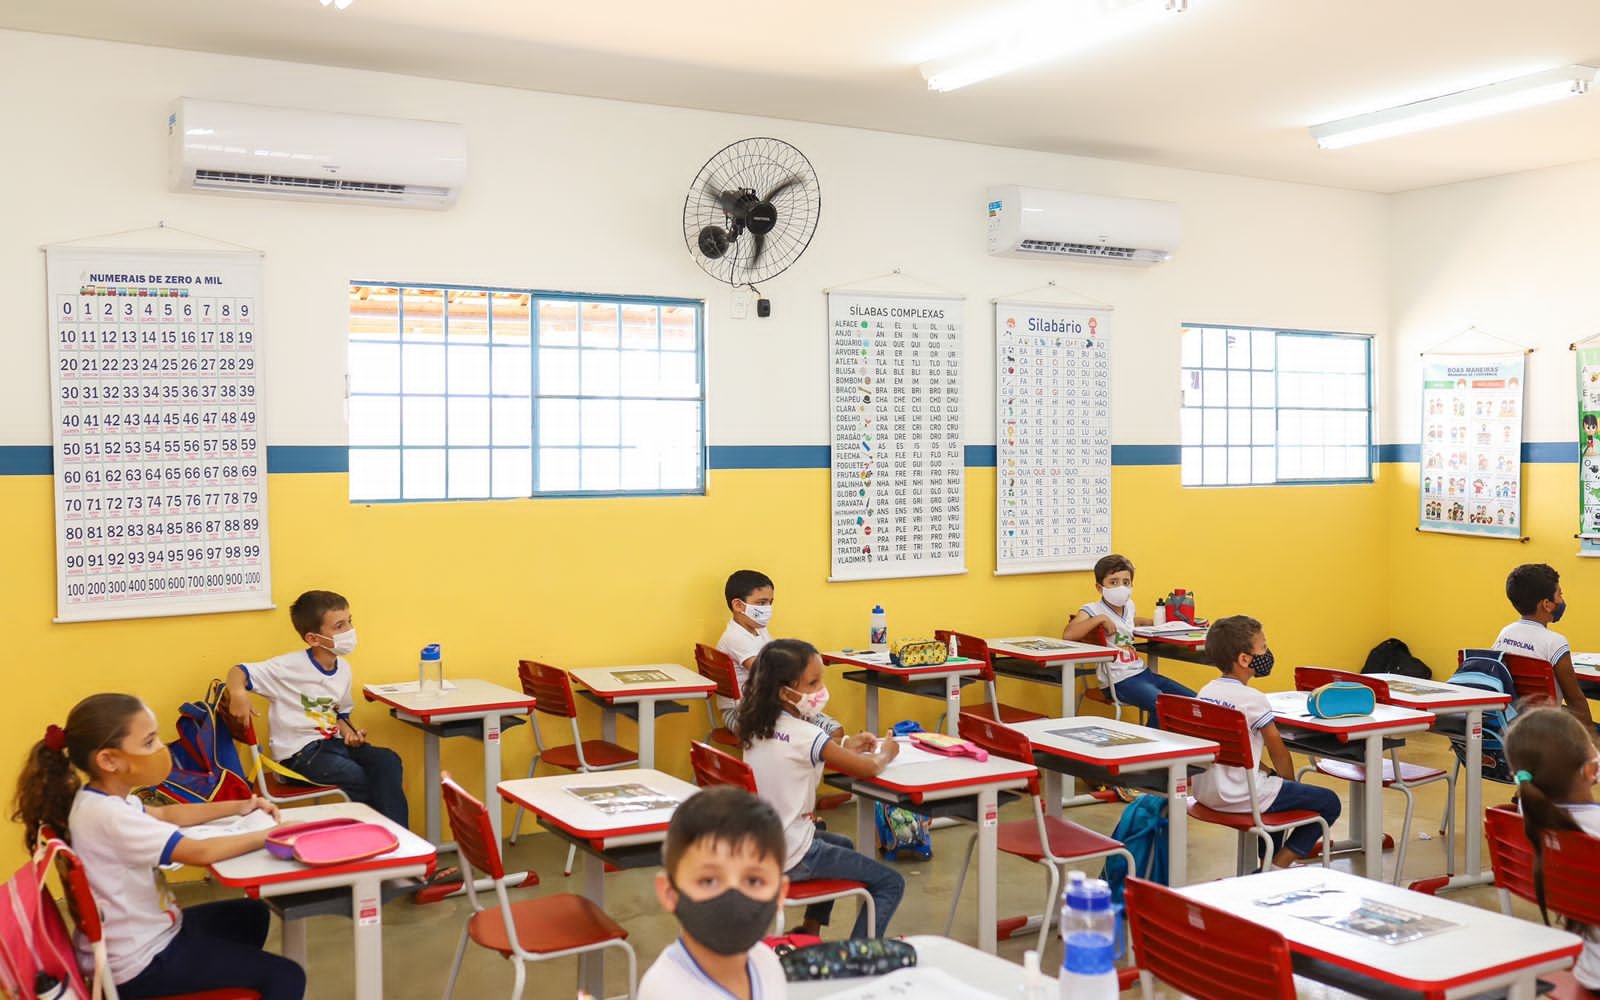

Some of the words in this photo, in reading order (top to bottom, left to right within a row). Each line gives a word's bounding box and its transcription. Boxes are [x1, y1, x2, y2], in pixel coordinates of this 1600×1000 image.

[90, 274, 146, 283] NUMERAIS
[149, 275, 162, 283] DE
[165, 276, 192, 284] ZERO
[195, 276, 201, 284] A
[205, 276, 222, 285] MIL
[63, 302, 72, 314] 0
[85, 303, 92, 315] 1
[104, 303, 112, 315] 2
[124, 303, 133, 316] 3
[144, 304, 152, 315] 4
[164, 304, 172, 316] 5
[184, 304, 192, 316] 6
[203, 304, 210, 316] 7
[222, 304, 230, 316] 8
[241, 304, 248, 316] 9
[850, 304, 888, 316] SÍLABAS
[891, 308, 944, 318] COMPLEXAS
[1028, 317, 1081, 334] Silabário
[60, 330, 76, 343] 10
[82, 331, 96, 343] 11
[102, 330, 117, 343] 12
[122, 330, 137, 343] 13
[142, 331, 156, 343] 14
[162, 331, 176, 343] 15
[182, 331, 196, 343] 16
[201, 331, 214, 343] 17
[220, 332, 234, 343] 18
[238, 331, 252, 344] 19
[60, 358, 78, 371] 20
[82, 358, 98, 371] 21
[102, 358, 118, 371] 22
[122, 358, 138, 370] 23
[142, 358, 158, 370] 24
[162, 358, 178, 370] 25
[181, 358, 198, 370] 26
[201, 358, 216, 370] 27
[219, 358, 236, 370] 28
[238, 358, 254, 370] 29
[64, 443, 80, 456] 50
[84, 442, 100, 455] 51
[104, 442, 121, 454] 52
[125, 441, 141, 454] 53
[144, 440, 161, 453] 54
[164, 440, 180, 452] 55
[184, 440, 200, 452] 56
[204, 439, 218, 452] 57
[222, 439, 238, 451] 58
[241, 438, 256, 450] 59
[65, 499, 82, 511] 70
[86, 498, 102, 510] 71
[106, 497, 122, 510] 72
[127, 496, 142, 509] 73
[147, 496, 162, 508] 74
[166, 495, 182, 507] 75
[186, 494, 201, 506] 76
[205, 493, 220, 505] 77
[224, 492, 239, 504] 78
[242, 492, 258, 504] 79
[66, 555, 84, 568] 90
[88, 554, 104, 567] 91
[108, 552, 125, 566] 92
[128, 552, 145, 564] 93
[148, 550, 164, 563] 94
[168, 550, 184, 562] 95
[187, 548, 203, 561] 96
[206, 547, 222, 560] 97
[225, 546, 241, 558] 98
[244, 545, 260, 557] 99
[838, 556, 866, 564] VLADIMIR
[68, 583, 85, 596] 100
[88, 582, 106, 595] 200
[108, 580, 127, 594] 300
[128, 579, 146, 592] 400
[148, 578, 166, 591] 500
[167, 576, 186, 590] 600
[187, 575, 204, 588] 700
[206, 574, 224, 587] 800
[225, 573, 243, 586] 900
[245, 572, 260, 584] 1000
[1503, 638, 1535, 652] PETROLINA
